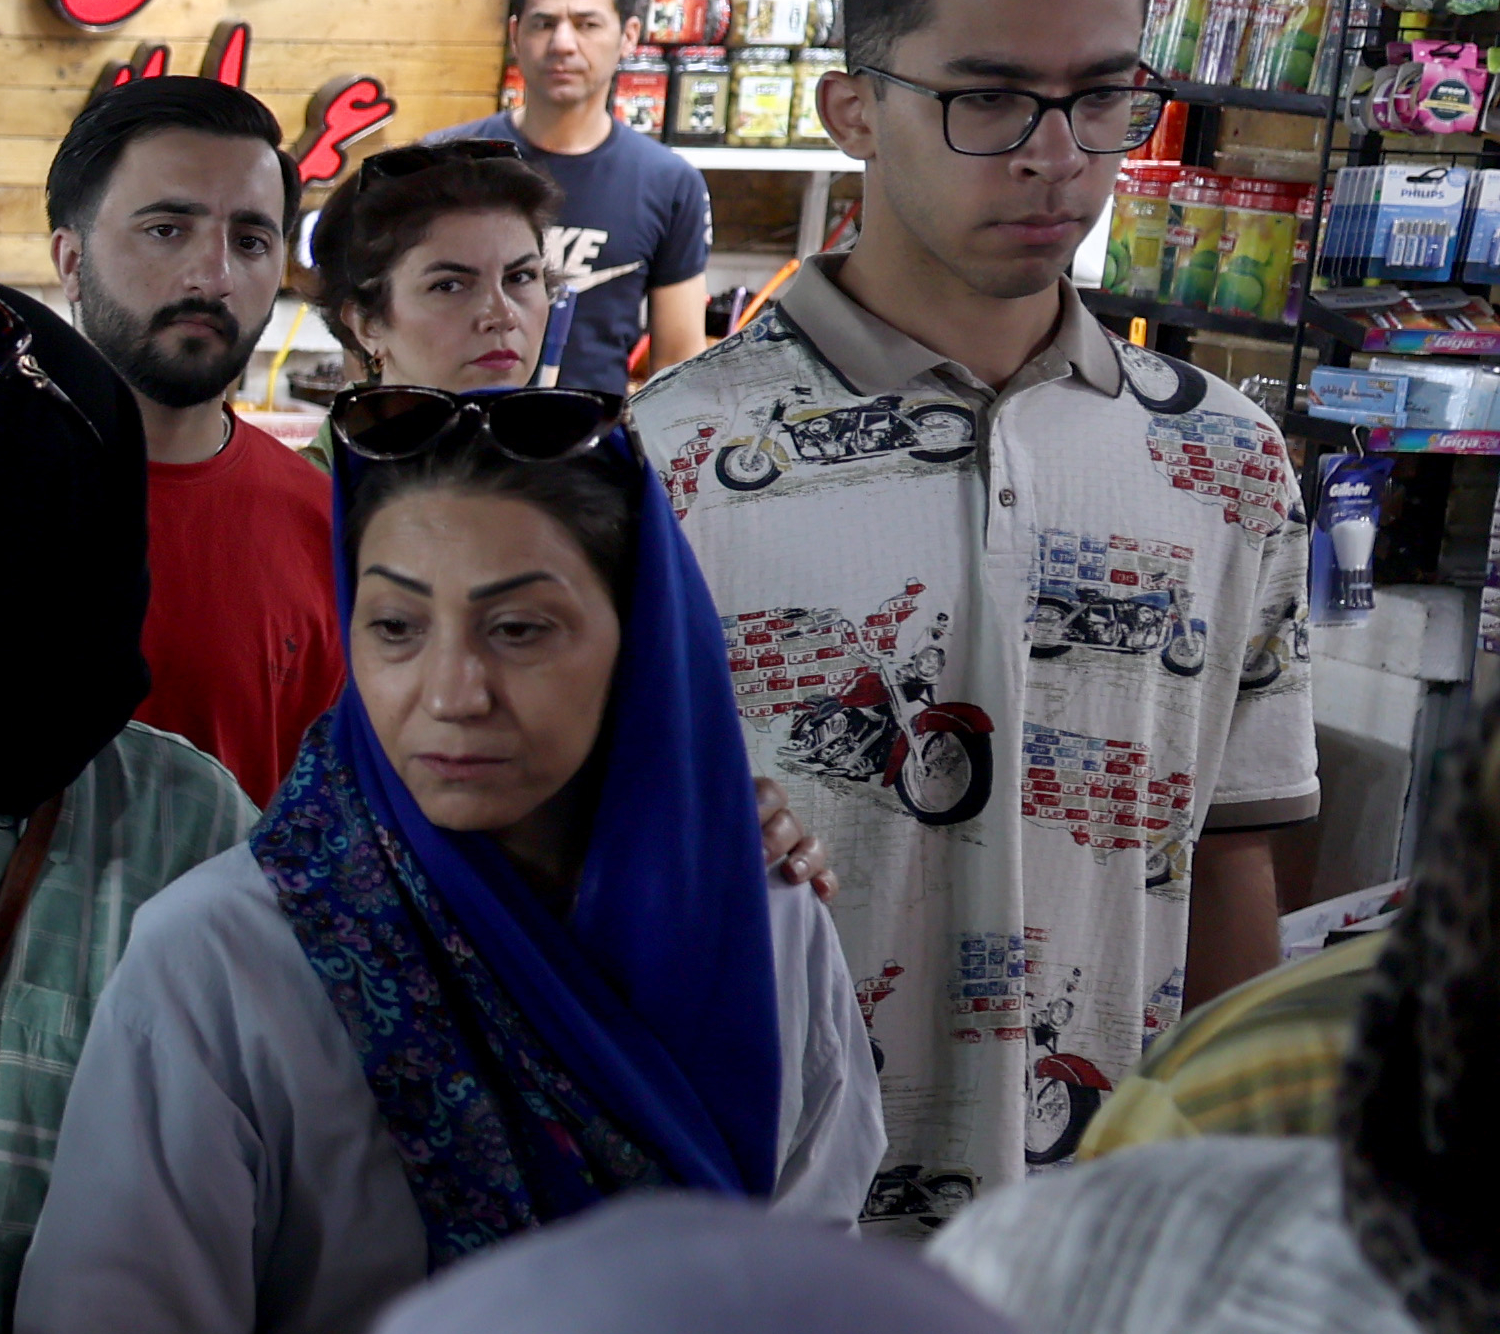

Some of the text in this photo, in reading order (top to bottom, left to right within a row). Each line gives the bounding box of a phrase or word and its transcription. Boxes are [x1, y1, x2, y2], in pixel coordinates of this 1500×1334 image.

[1400, 187, 1446, 201] PHILIPS
[546, 225, 609, 274] KE
[1328, 481, 1372, 498] Gillette
